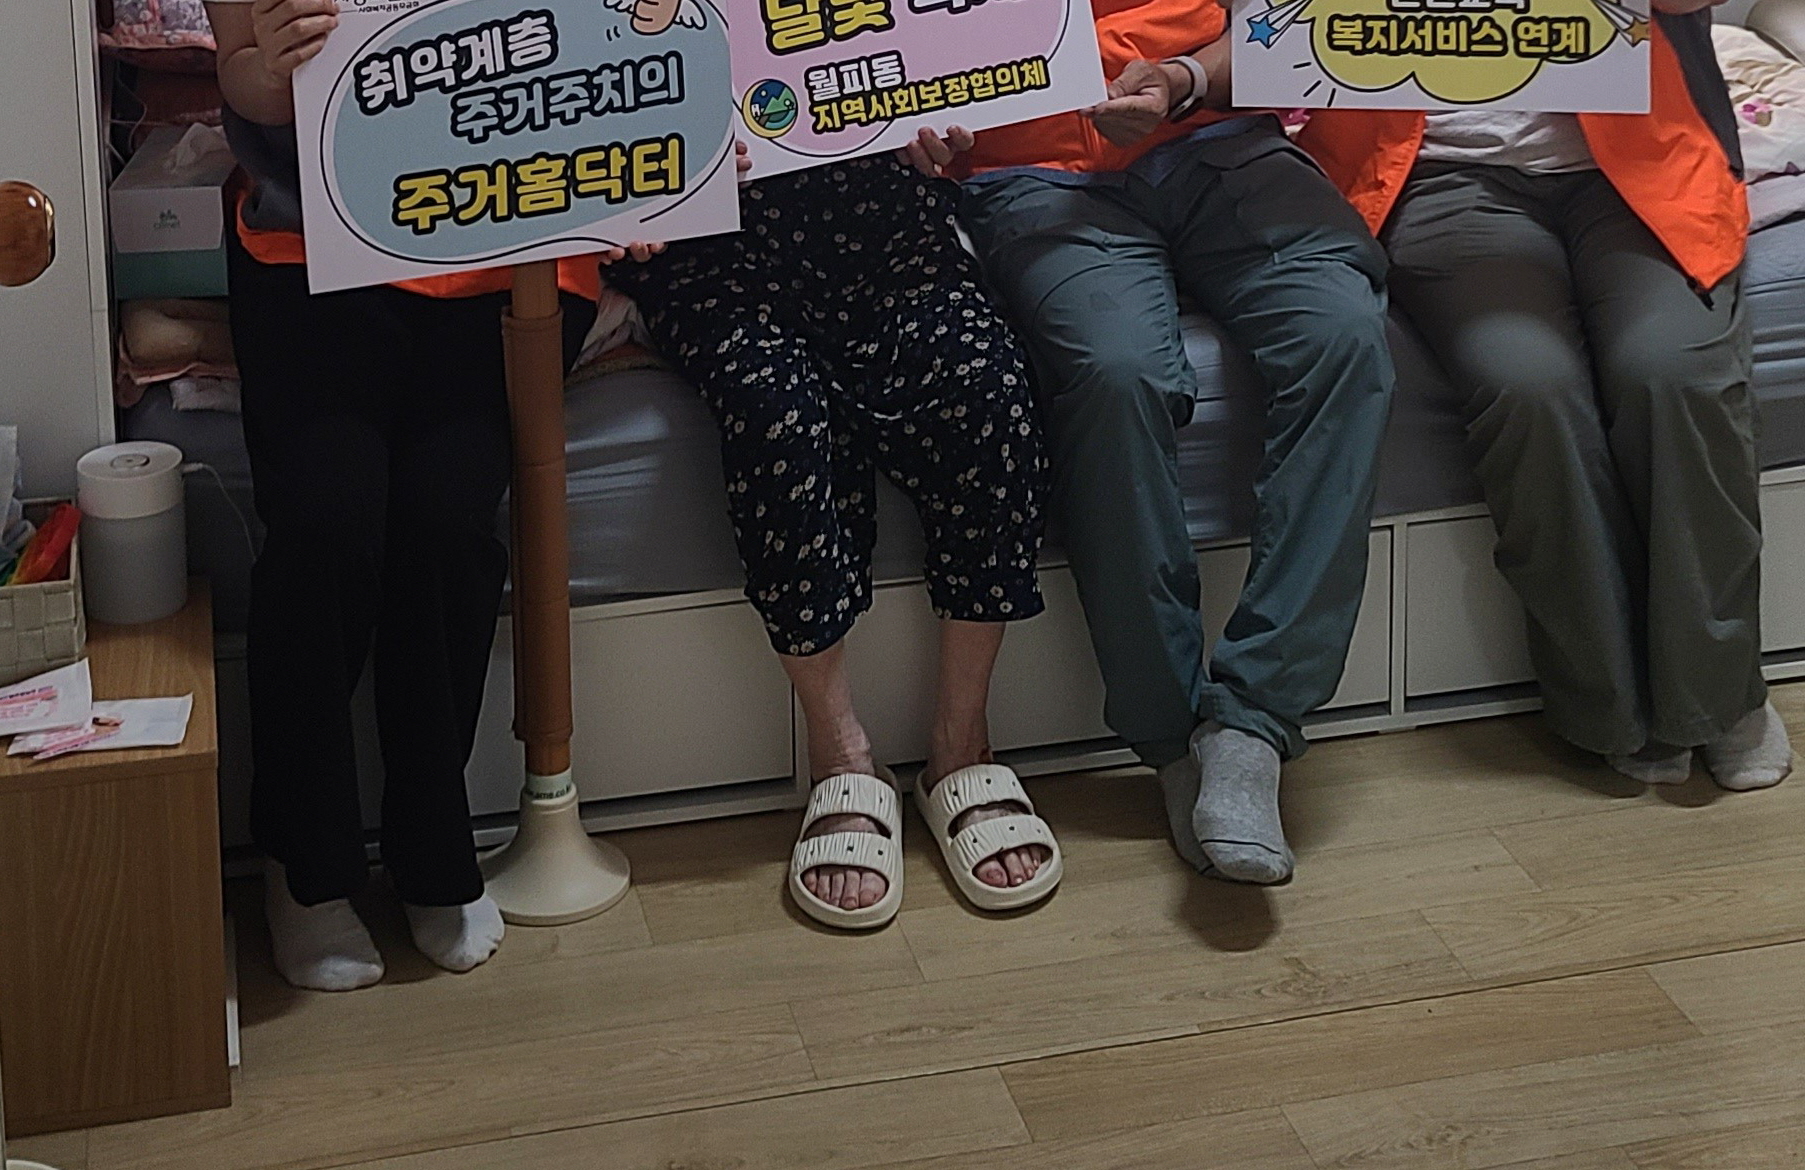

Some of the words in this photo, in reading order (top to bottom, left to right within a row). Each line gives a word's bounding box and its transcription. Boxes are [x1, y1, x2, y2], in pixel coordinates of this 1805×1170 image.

[357, 13, 556, 112] 취약계층
[1329, 17, 1505, 54] 복지서비스
[1517, 19, 1588, 56] 연계
[453, 53, 683, 141] 주거주치의
[807, 54, 904, 102] 월피동
[811, 59, 1049, 131] 지역사회보장협의체
[395, 136, 682, 232] 주거홈닥터
